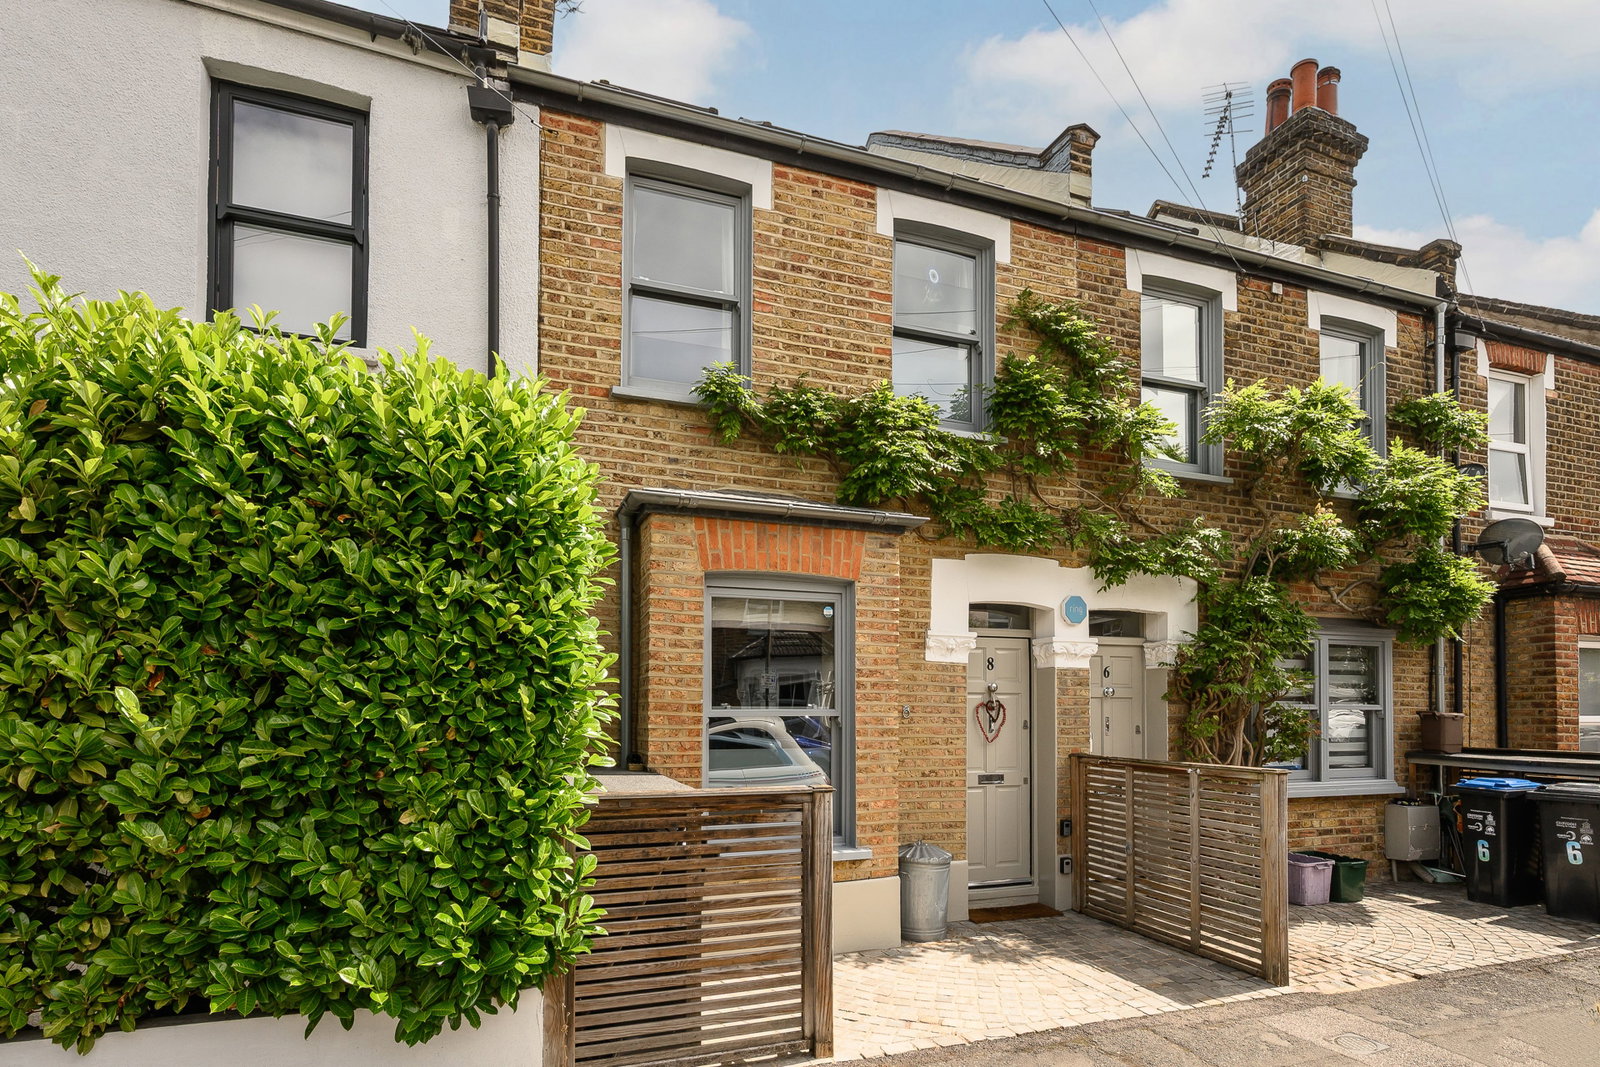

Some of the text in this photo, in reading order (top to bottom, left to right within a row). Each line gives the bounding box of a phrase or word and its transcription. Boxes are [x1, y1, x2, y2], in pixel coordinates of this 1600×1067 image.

[1069, 604, 1083, 616] ring
[986, 657, 995, 671] 8
[1103, 666, 1110, 678] 6
[1477, 839, 1490, 862] 6
[1566, 841, 1583, 865] 6
